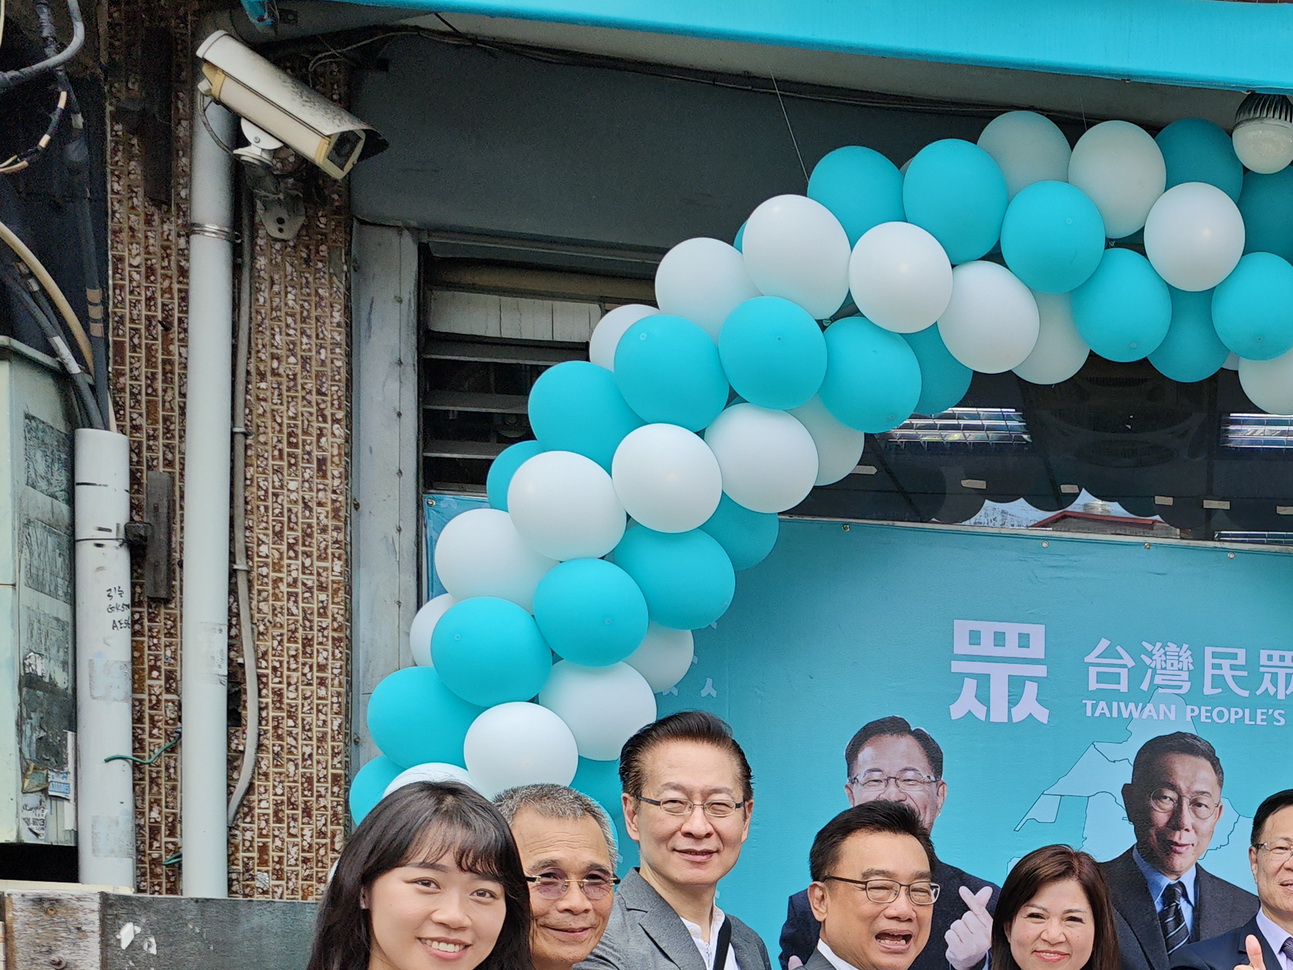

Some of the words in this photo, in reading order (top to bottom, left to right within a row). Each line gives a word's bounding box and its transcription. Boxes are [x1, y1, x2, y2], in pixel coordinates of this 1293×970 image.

[949, 619, 1050, 724] 眾
[1082, 699, 1176, 721] TAIWAN
[1185, 705, 1286, 727] PEOPLE'S
